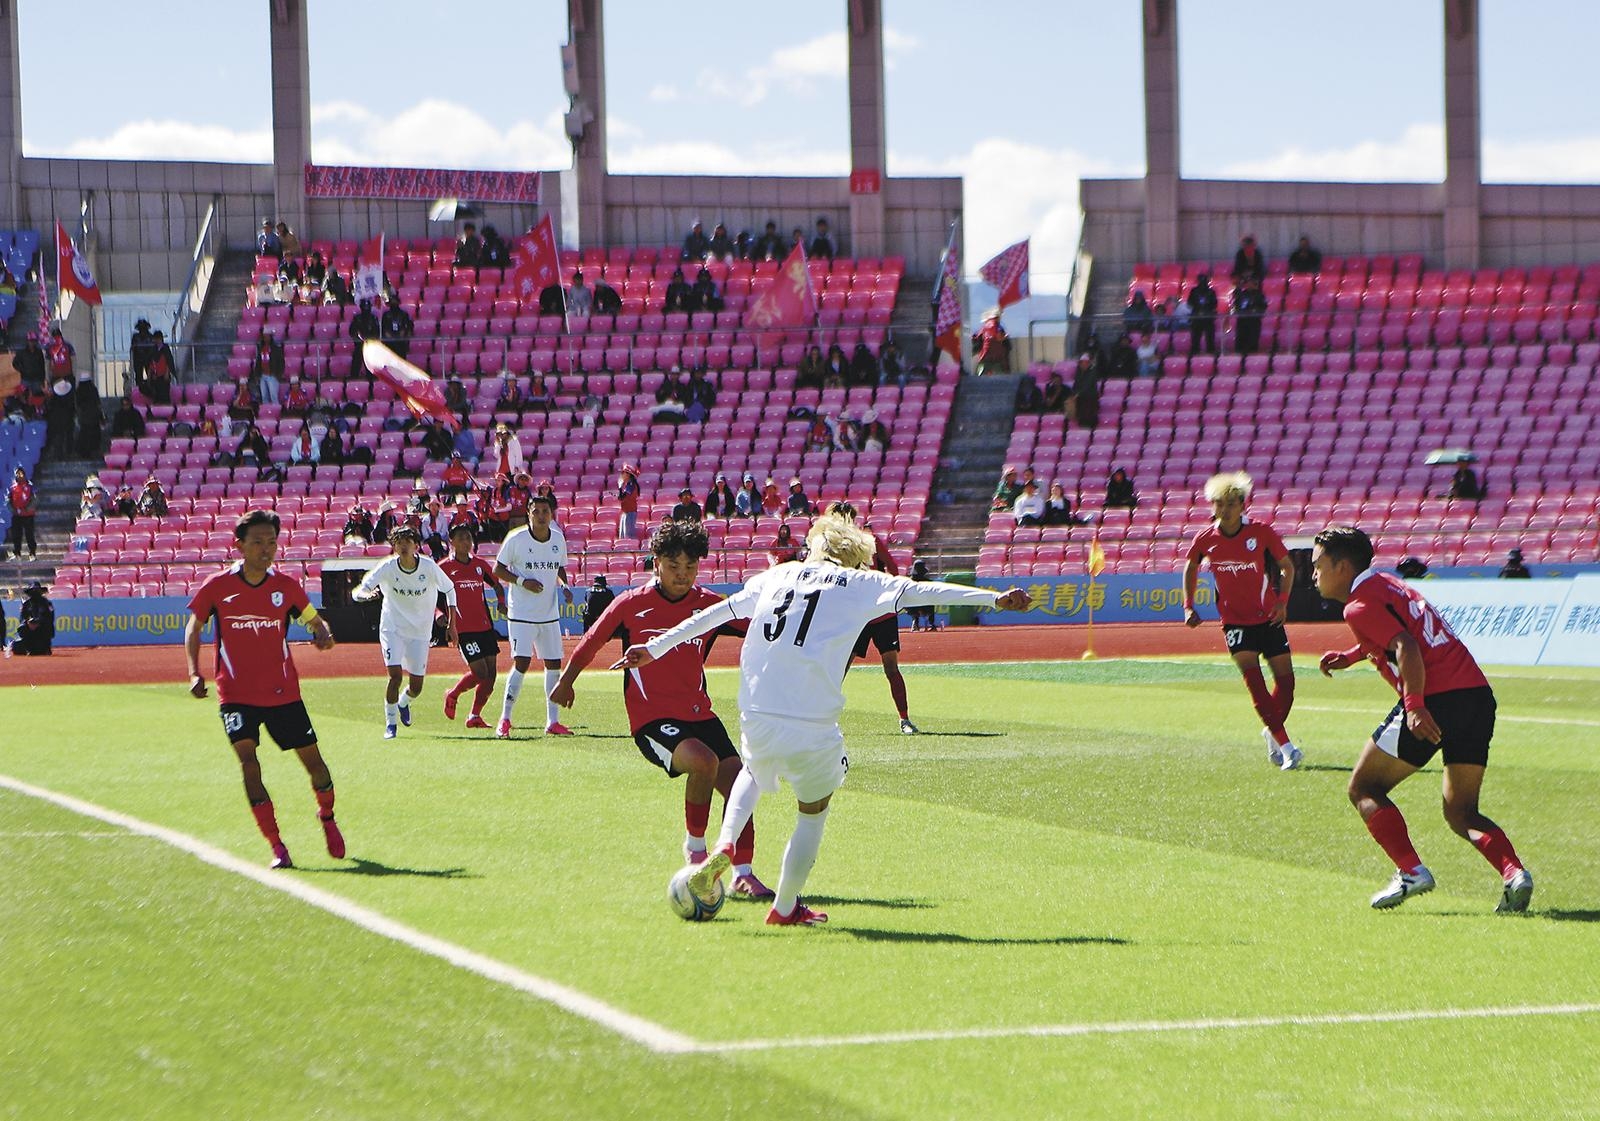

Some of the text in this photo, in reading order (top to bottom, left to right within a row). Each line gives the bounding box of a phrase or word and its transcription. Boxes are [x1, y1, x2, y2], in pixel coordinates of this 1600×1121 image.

[763, 588, 822, 648] 31
[1226, 628, 1243, 648] 87
[466, 641, 480, 656] 98
